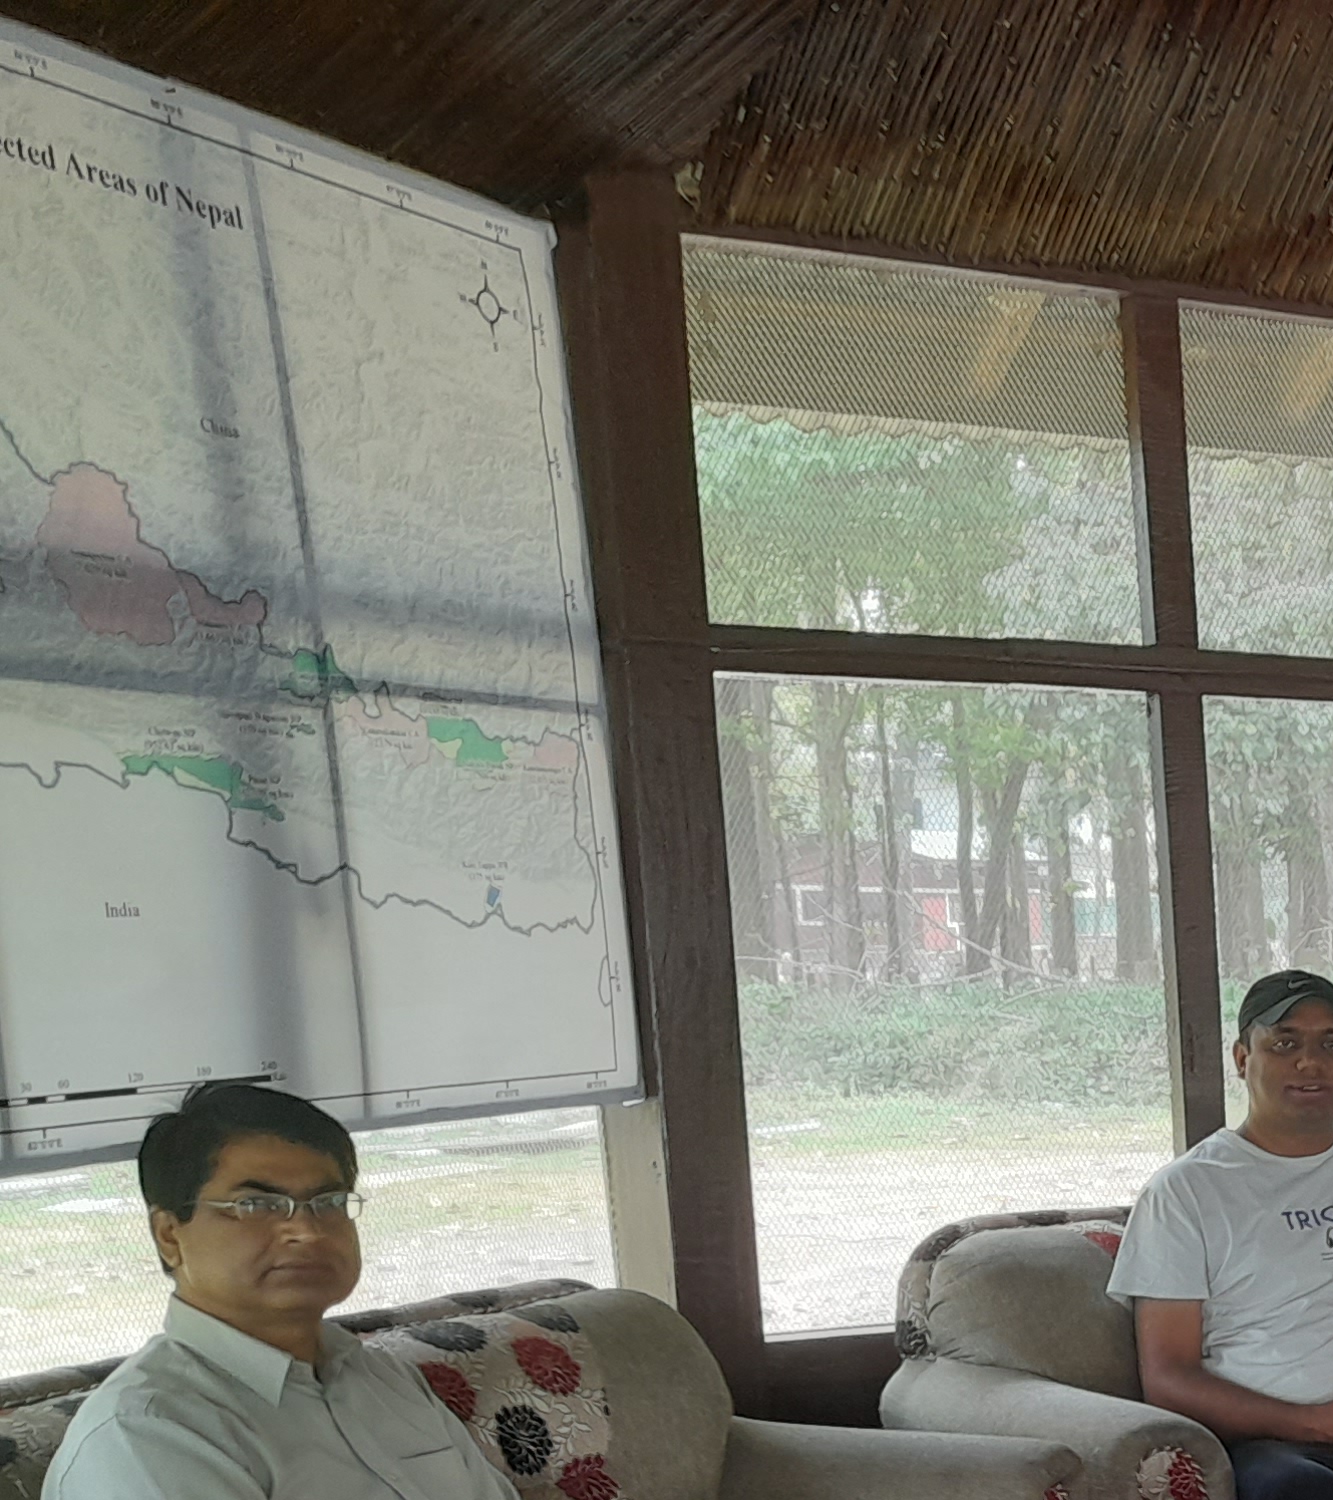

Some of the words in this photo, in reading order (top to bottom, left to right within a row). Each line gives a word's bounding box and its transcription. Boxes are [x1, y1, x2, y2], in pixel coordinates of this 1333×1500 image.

[66, 152, 138, 197] Areas
[145, 180, 169, 206] of
[175, 185, 243, 230] Nepal
[105, 901, 141, 918] India
[127, 1073, 144, 1083] 120
